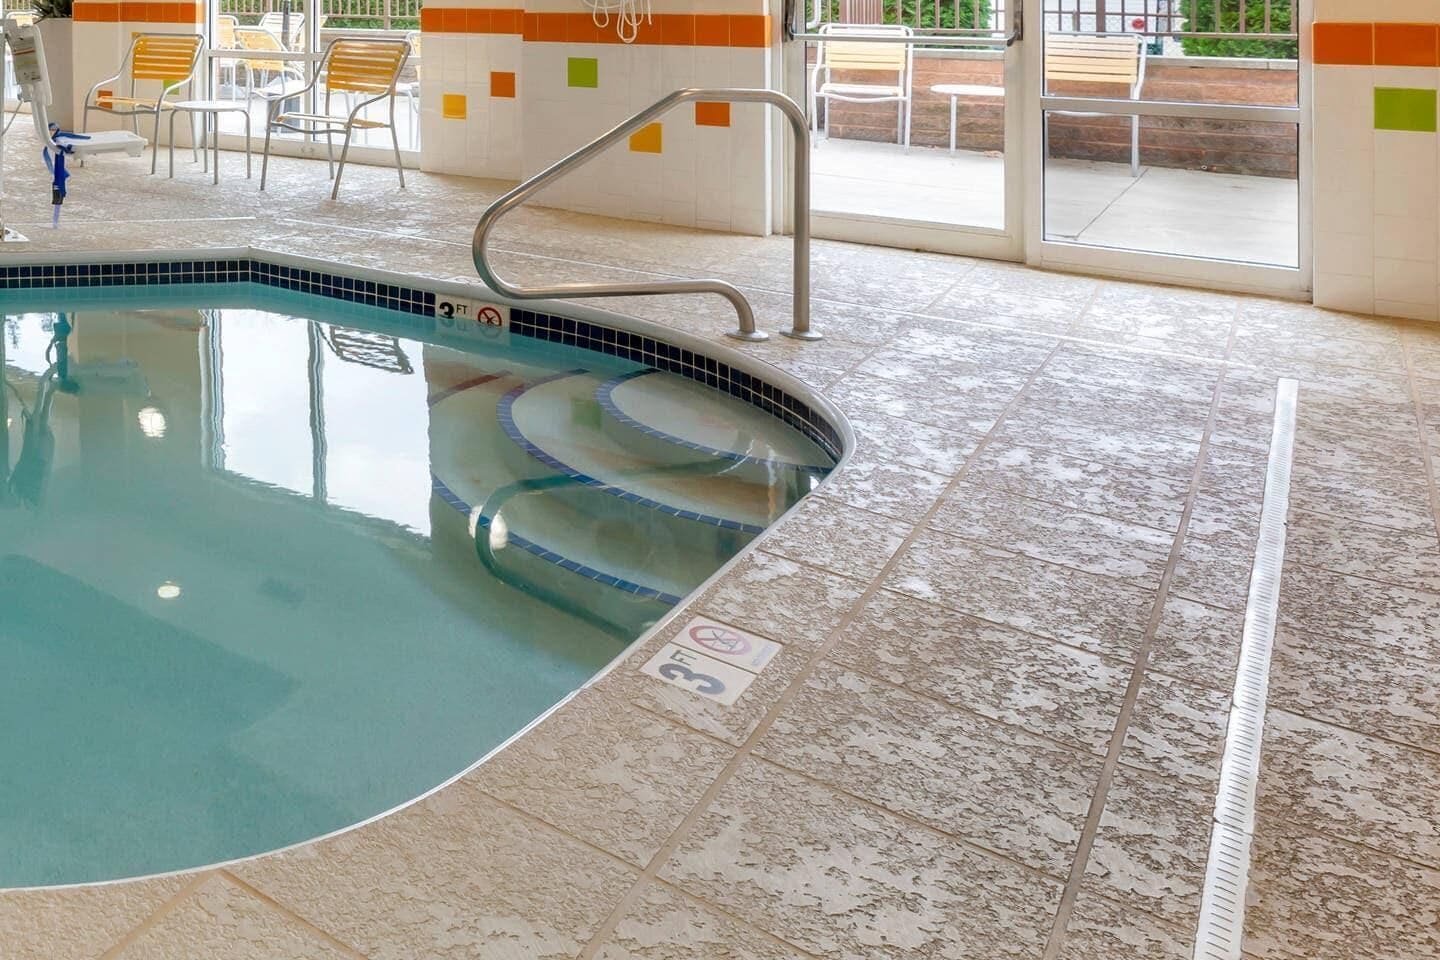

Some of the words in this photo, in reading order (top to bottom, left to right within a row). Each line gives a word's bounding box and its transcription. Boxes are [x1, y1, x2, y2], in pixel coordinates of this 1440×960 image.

[457, 304, 468, 314] FT
[670, 649, 697, 666] FT
[658, 663, 726, 695] 3
